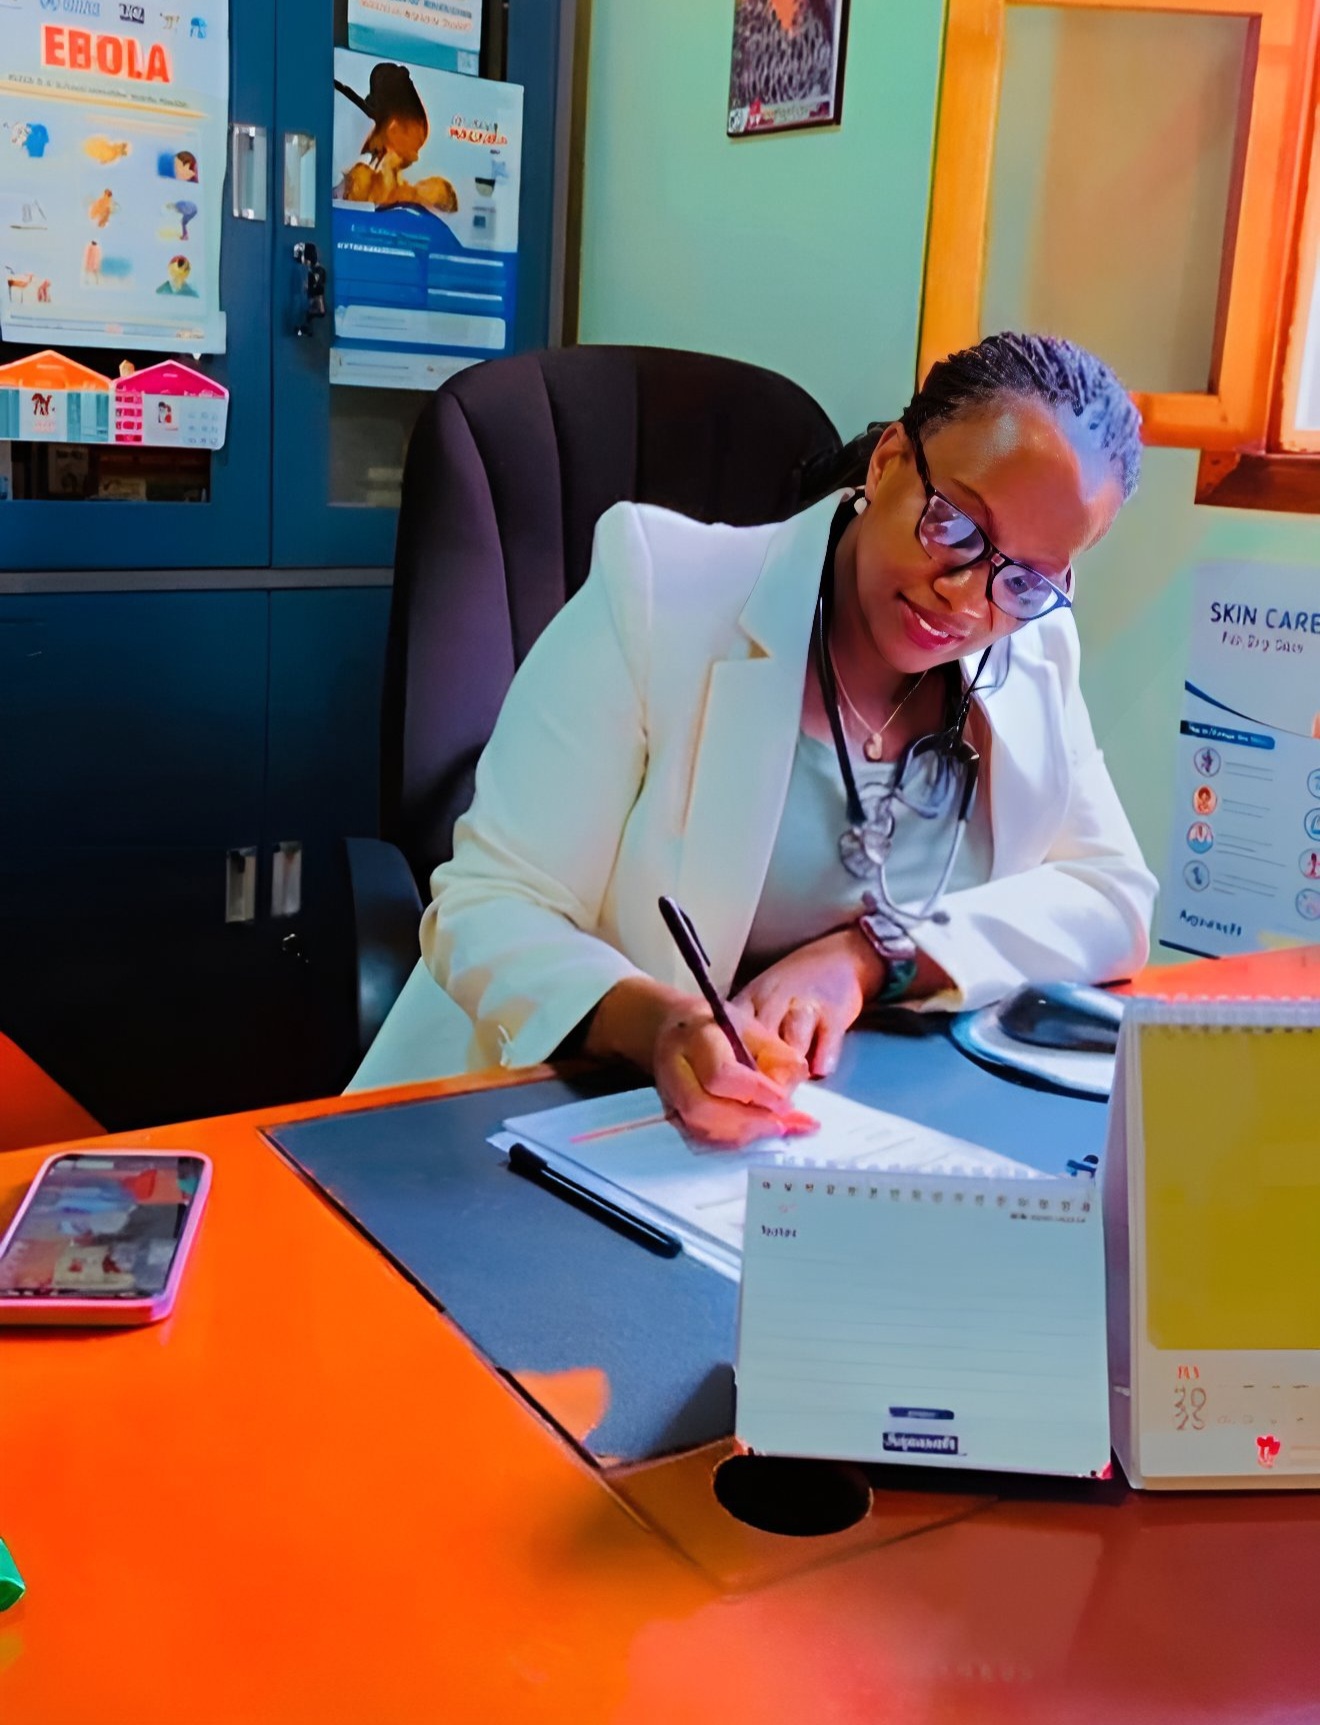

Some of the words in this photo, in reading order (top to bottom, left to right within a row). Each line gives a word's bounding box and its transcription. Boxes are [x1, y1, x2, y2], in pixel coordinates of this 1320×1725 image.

[44, 25, 170, 84] EBOLA
[1211, 601, 1258, 626] SKIN
[1265, 607, 1320, 635] CARE
